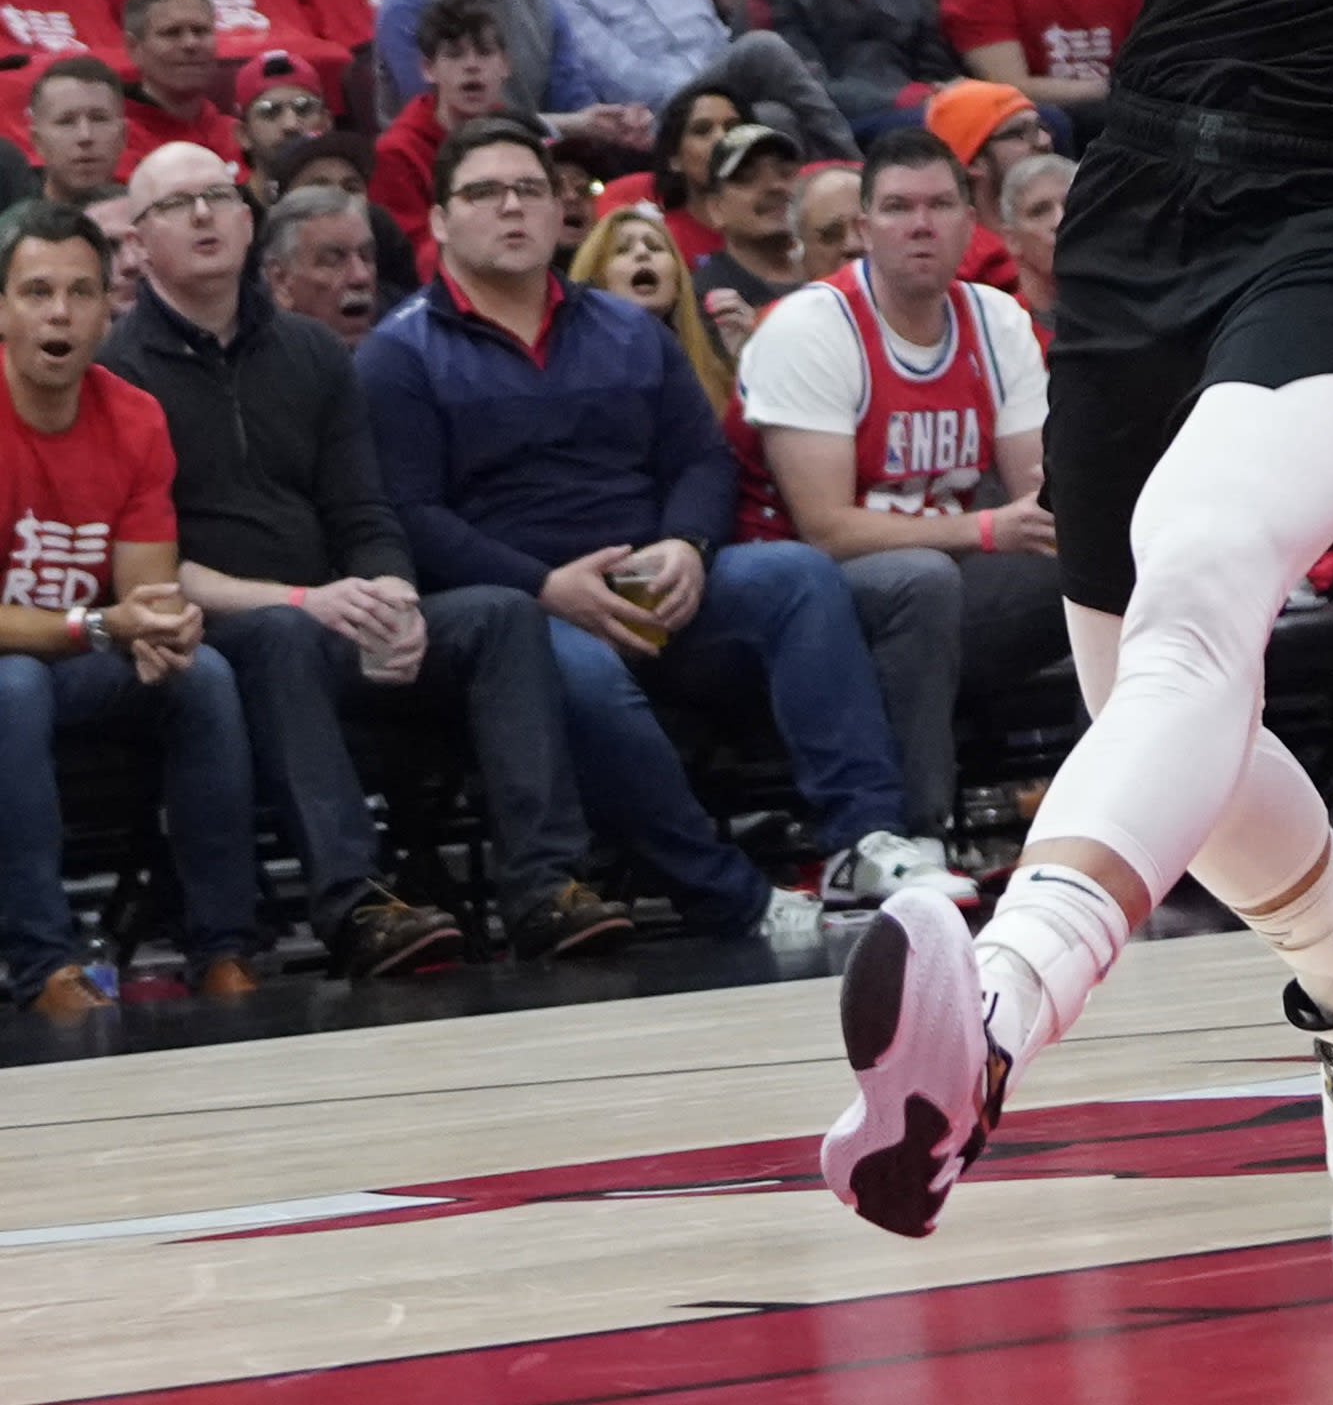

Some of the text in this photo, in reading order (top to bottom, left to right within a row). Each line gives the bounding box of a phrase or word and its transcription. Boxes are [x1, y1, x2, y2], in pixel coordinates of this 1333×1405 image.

[911, 407, 980, 471] NBA
[10, 508, 110, 567] SEE
[2, 566, 99, 610] RED
